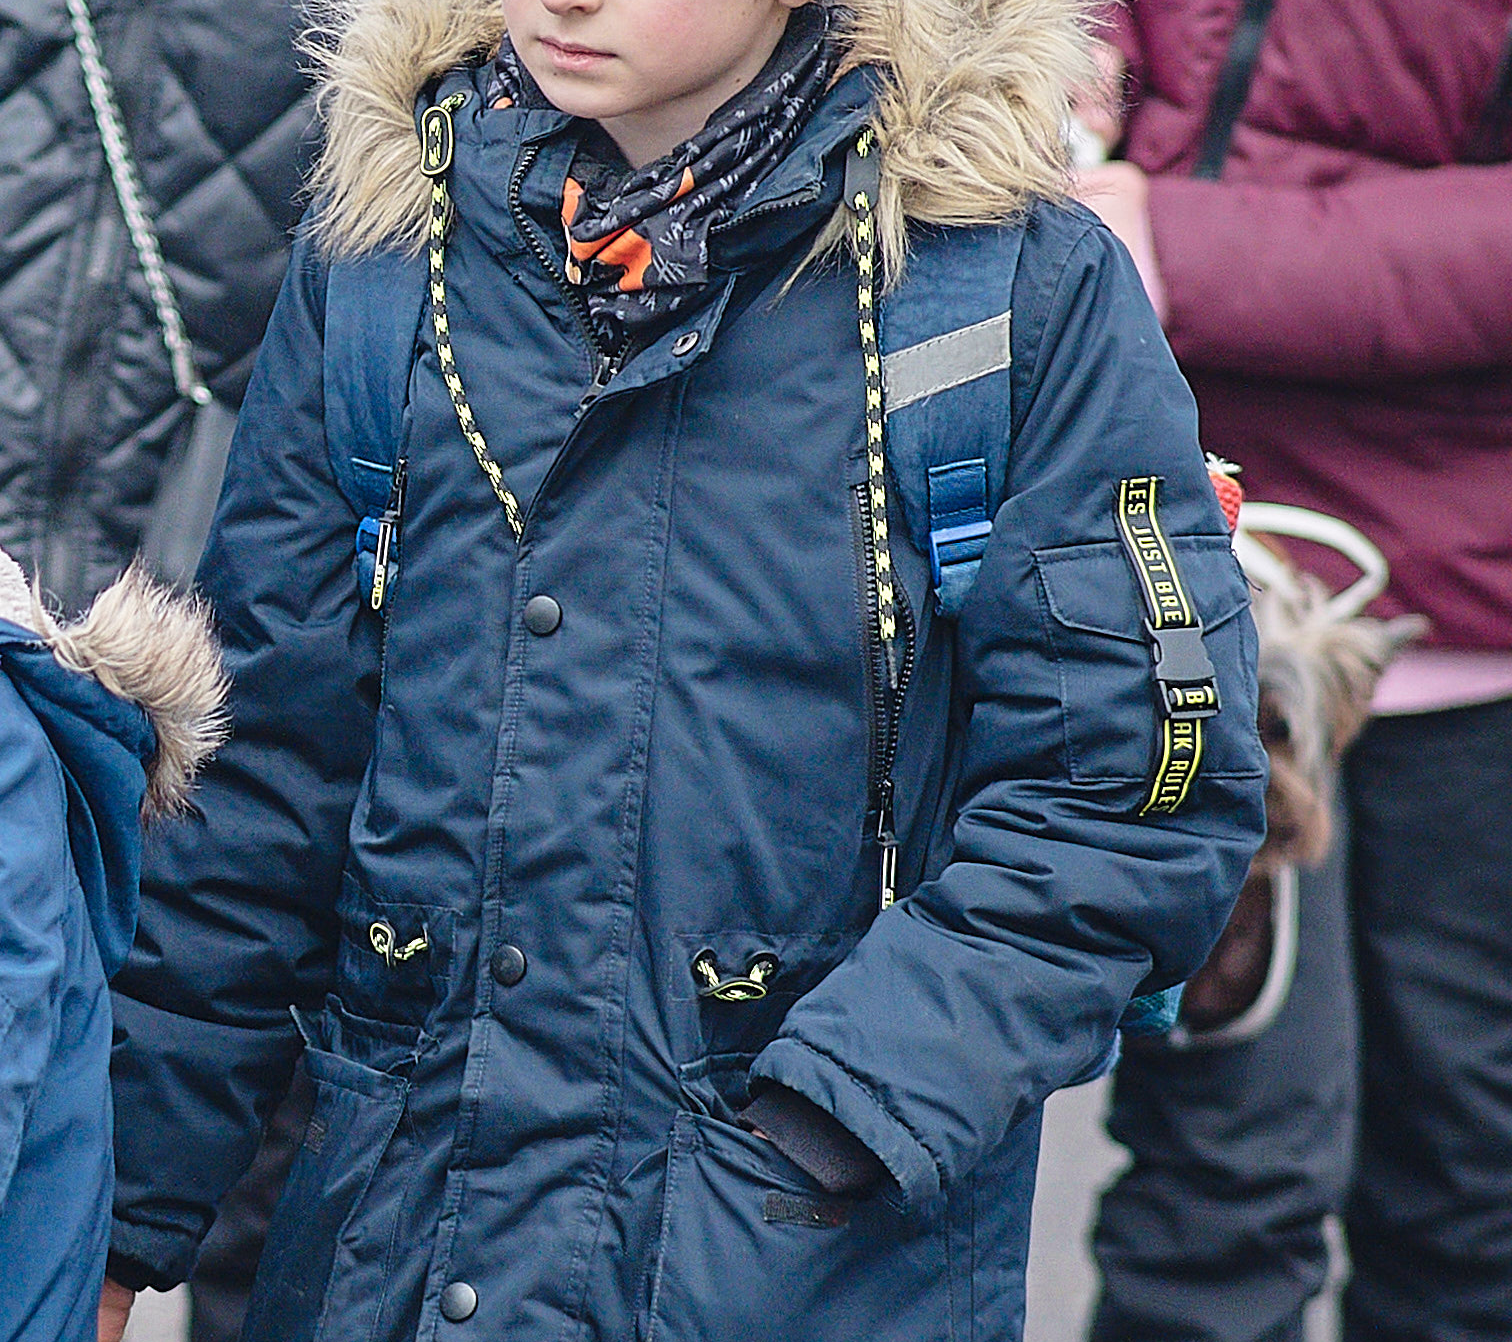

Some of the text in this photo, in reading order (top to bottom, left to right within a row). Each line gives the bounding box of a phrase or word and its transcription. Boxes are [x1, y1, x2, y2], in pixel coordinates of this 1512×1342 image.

[1131, 526, 1168, 574] JUST
[1154, 579, 1183, 623] BRE
[1173, 722, 1193, 750] AK
